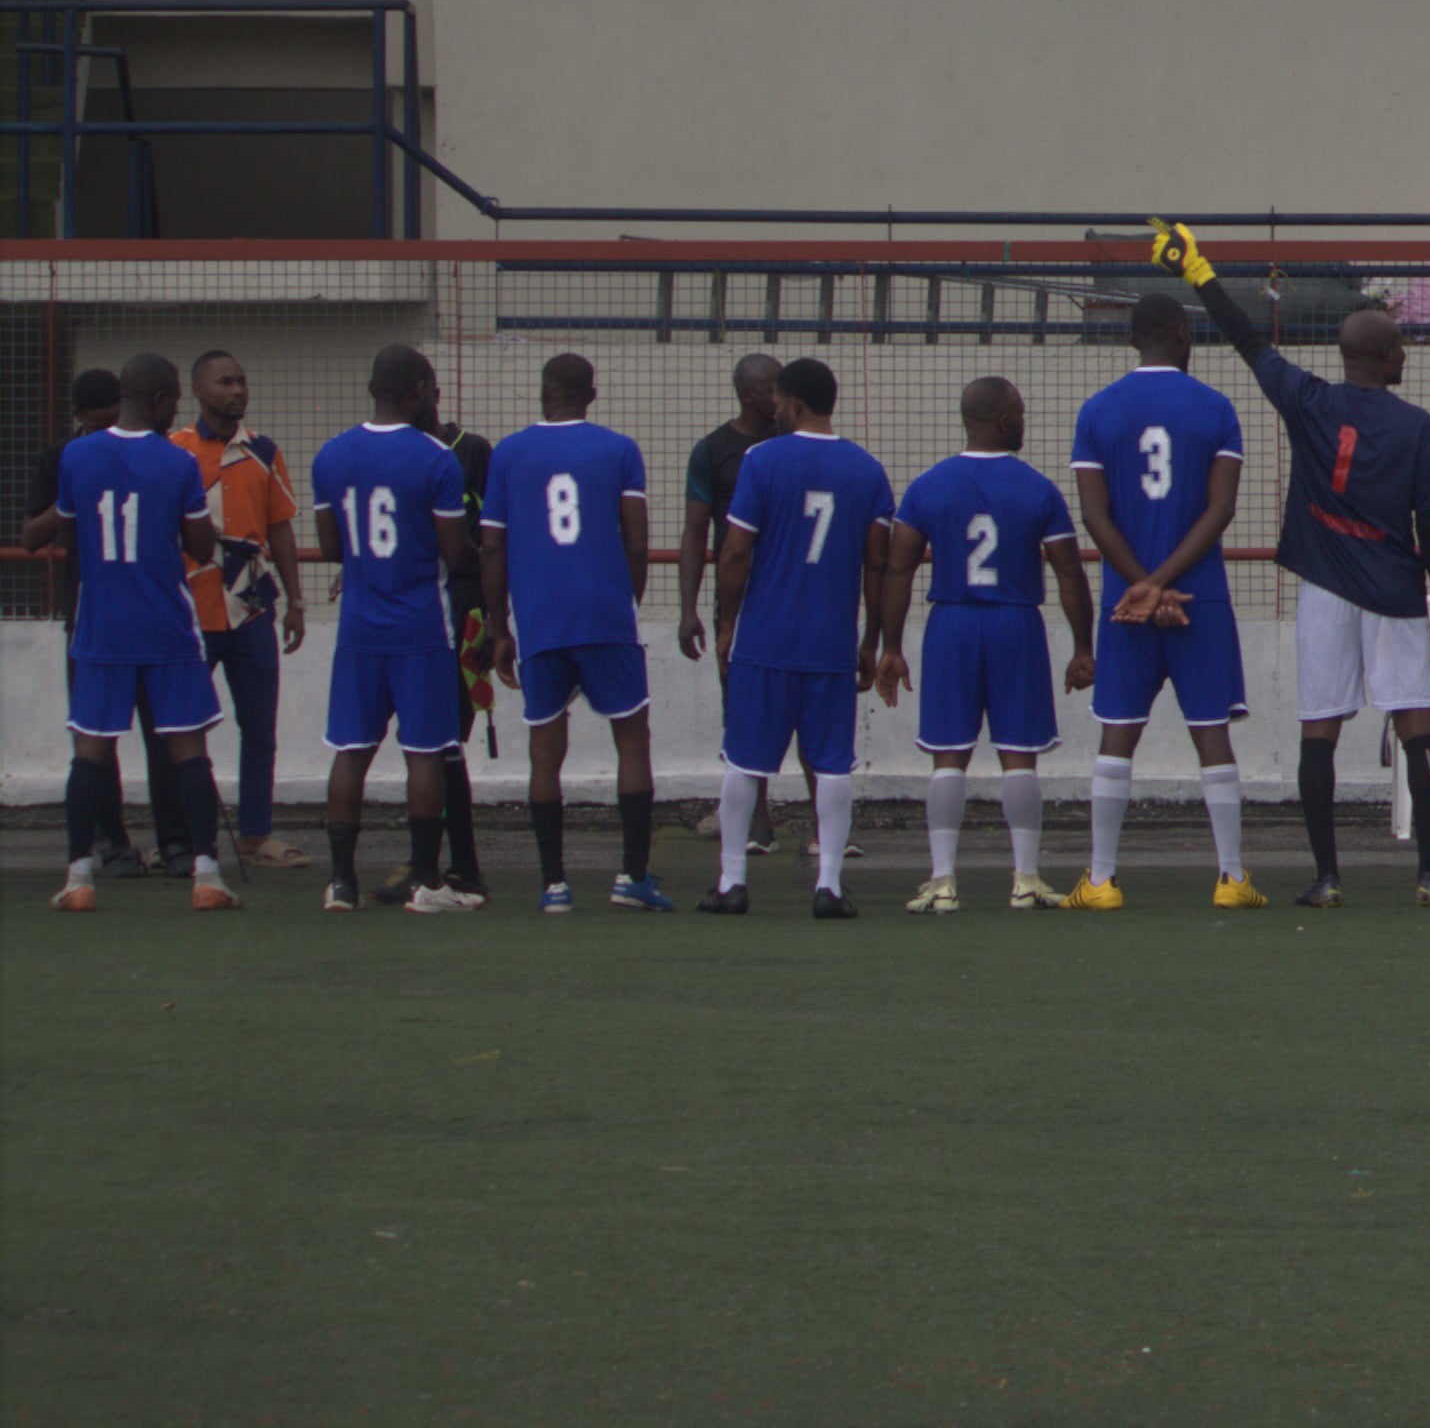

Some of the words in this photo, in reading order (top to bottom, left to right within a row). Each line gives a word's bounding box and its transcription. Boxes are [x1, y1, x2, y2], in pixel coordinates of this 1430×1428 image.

[1140, 427, 1171, 499] 3
[97, 490, 137, 562] 11
[343, 487, 396, 558] 16
[547, 474, 580, 544] 8
[805, 492, 834, 563] 7
[968, 514, 997, 585] 2
